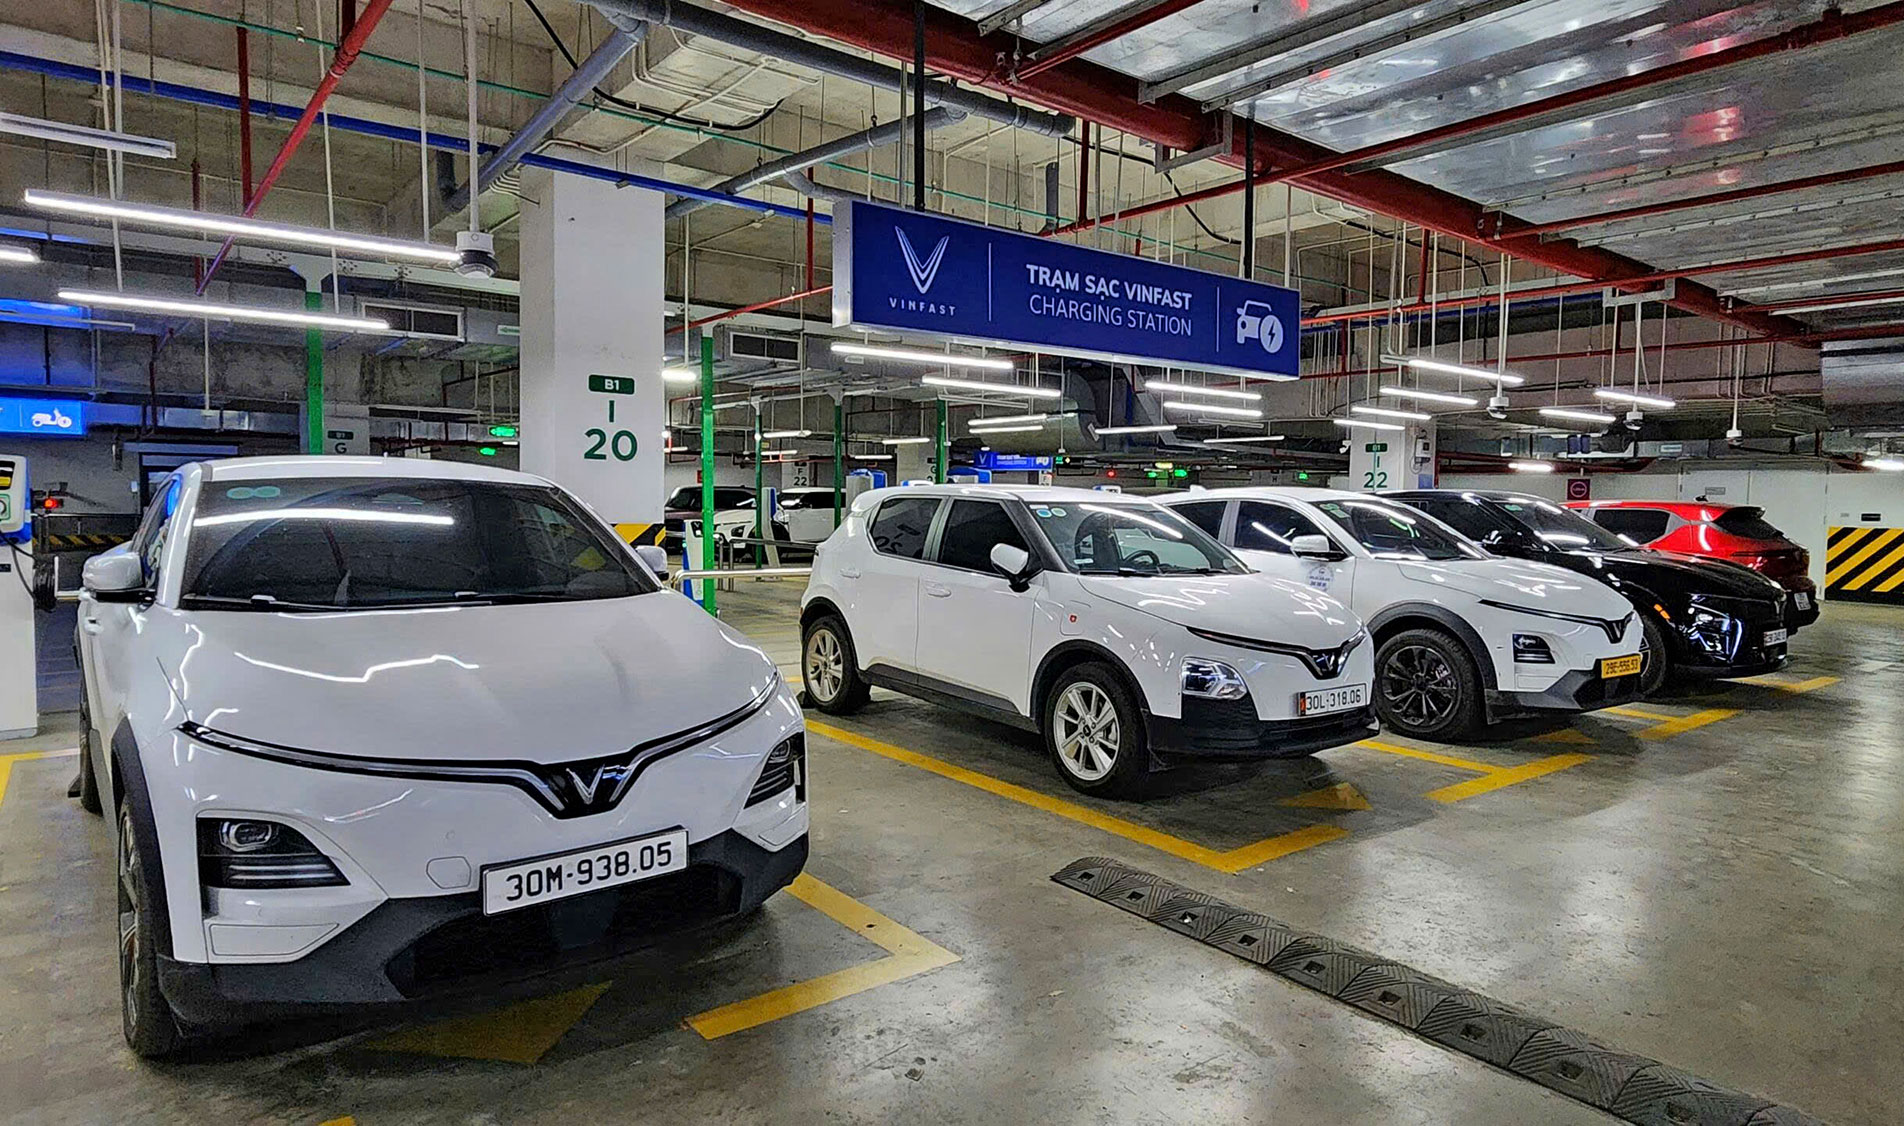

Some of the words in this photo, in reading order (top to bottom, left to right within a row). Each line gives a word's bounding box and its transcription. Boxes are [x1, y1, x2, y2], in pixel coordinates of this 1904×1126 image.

[1026, 264, 1079, 293] TRẠM
[1085, 275, 1120, 300] SẠC
[1124, 281, 1192, 310] VINFAST
[889, 297, 956, 316] VINFAST
[1030, 294, 1122, 326] CHARGING
[1127, 309, 1192, 336] STATION
[604, 379, 620, 391] B1
[335, 442, 347, 454] G
[584, 428, 638, 461] 20
[794, 477, 807, 486] 22
[1363, 472, 1388, 488] 22
[1306, 689, 1361, 710] 30L-318.06
[506, 841, 672, 902] 30M-938.05
